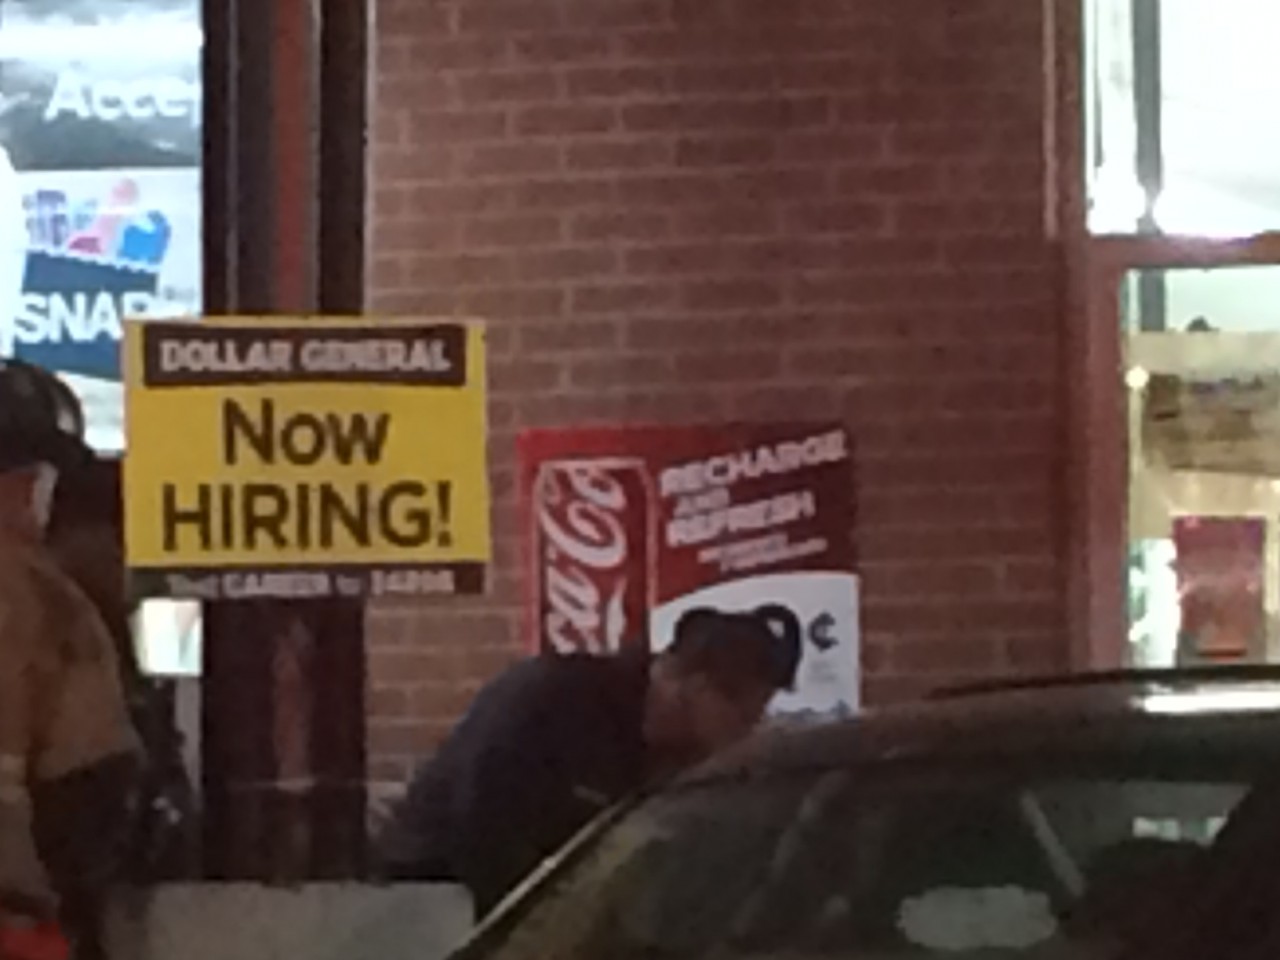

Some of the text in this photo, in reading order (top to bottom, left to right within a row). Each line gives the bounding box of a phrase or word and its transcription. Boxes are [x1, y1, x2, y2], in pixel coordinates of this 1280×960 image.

[159, 338, 452, 373] DOLLAR GENERAL
[161, 480, 453, 551] HIRING!
